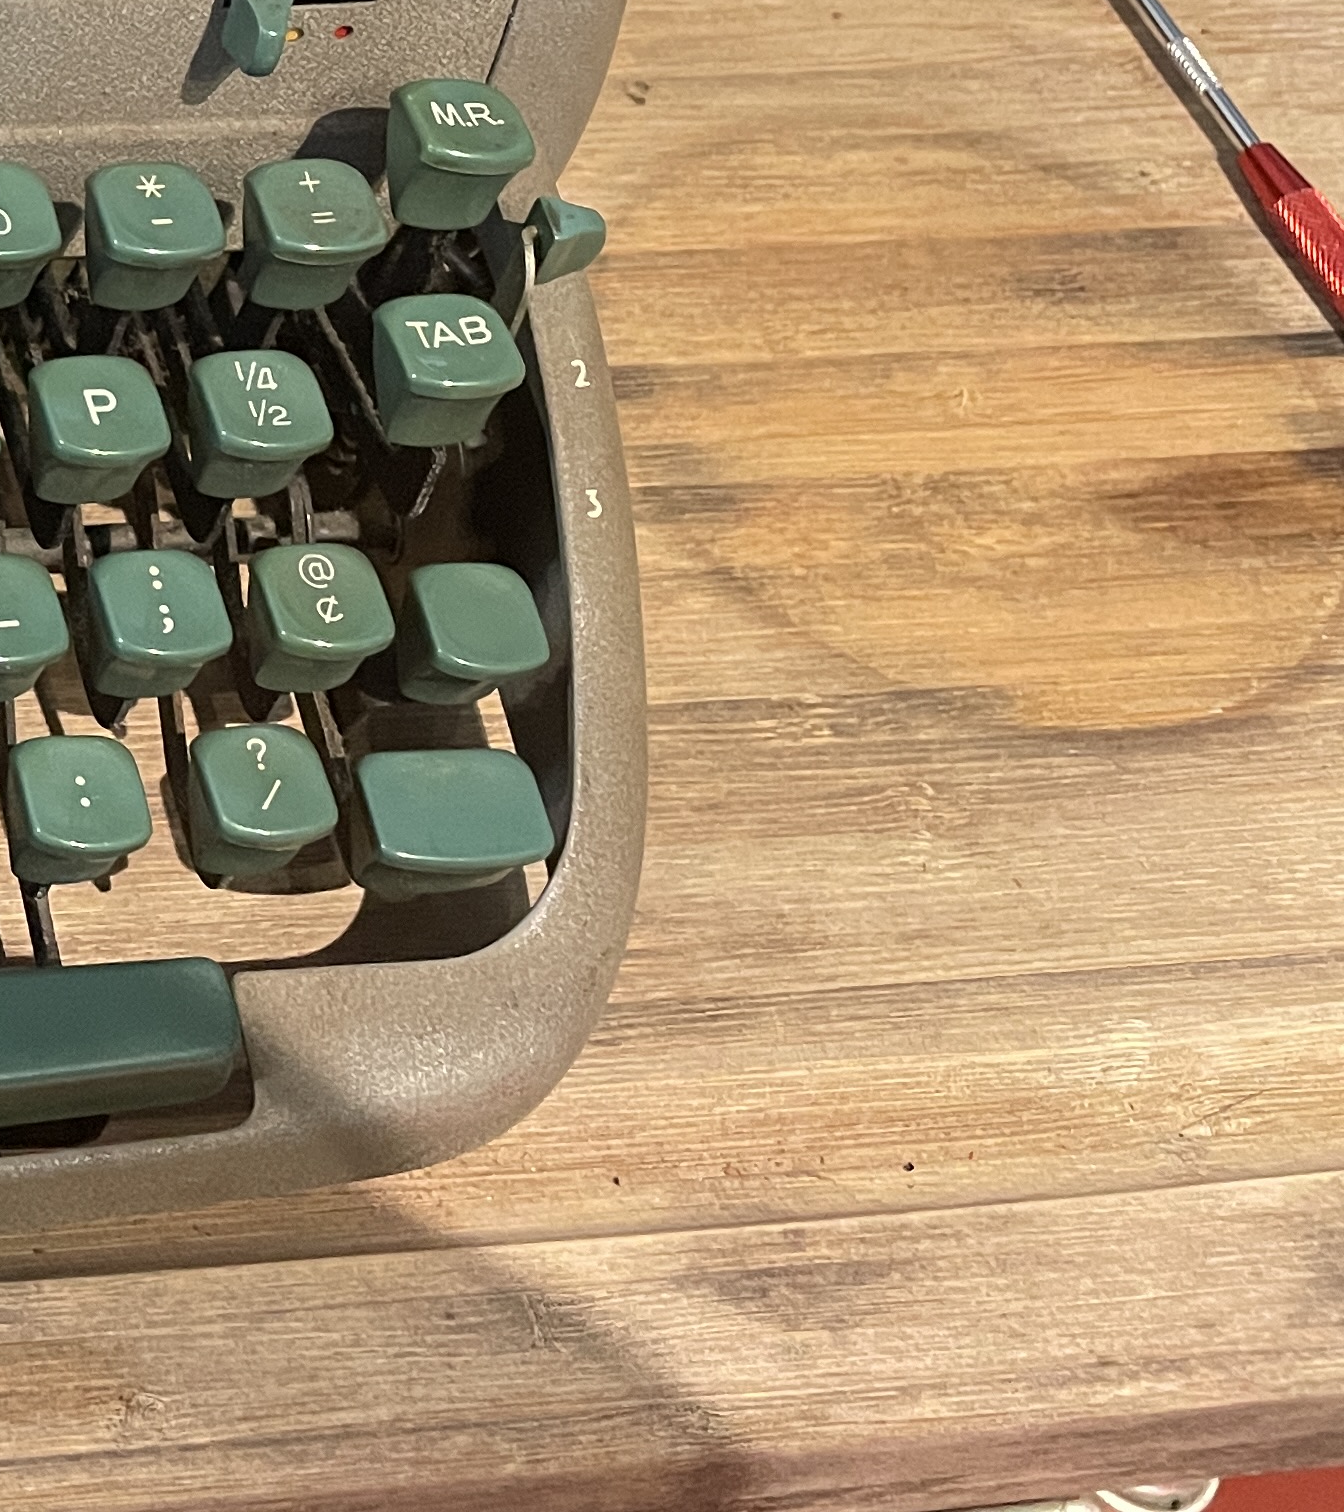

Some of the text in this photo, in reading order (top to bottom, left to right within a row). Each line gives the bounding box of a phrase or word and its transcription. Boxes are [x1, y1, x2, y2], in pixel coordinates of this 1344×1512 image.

[429, 100, 505, 129] M.R.
[404, 314, 493, 350] TAB
[570, 359, 591, 389] 2
[82, 387, 118, 426] P
[584, 489, 604, 519] 3
[297, 551, 336, 590] @
[246, 736, 268, 771] ?
